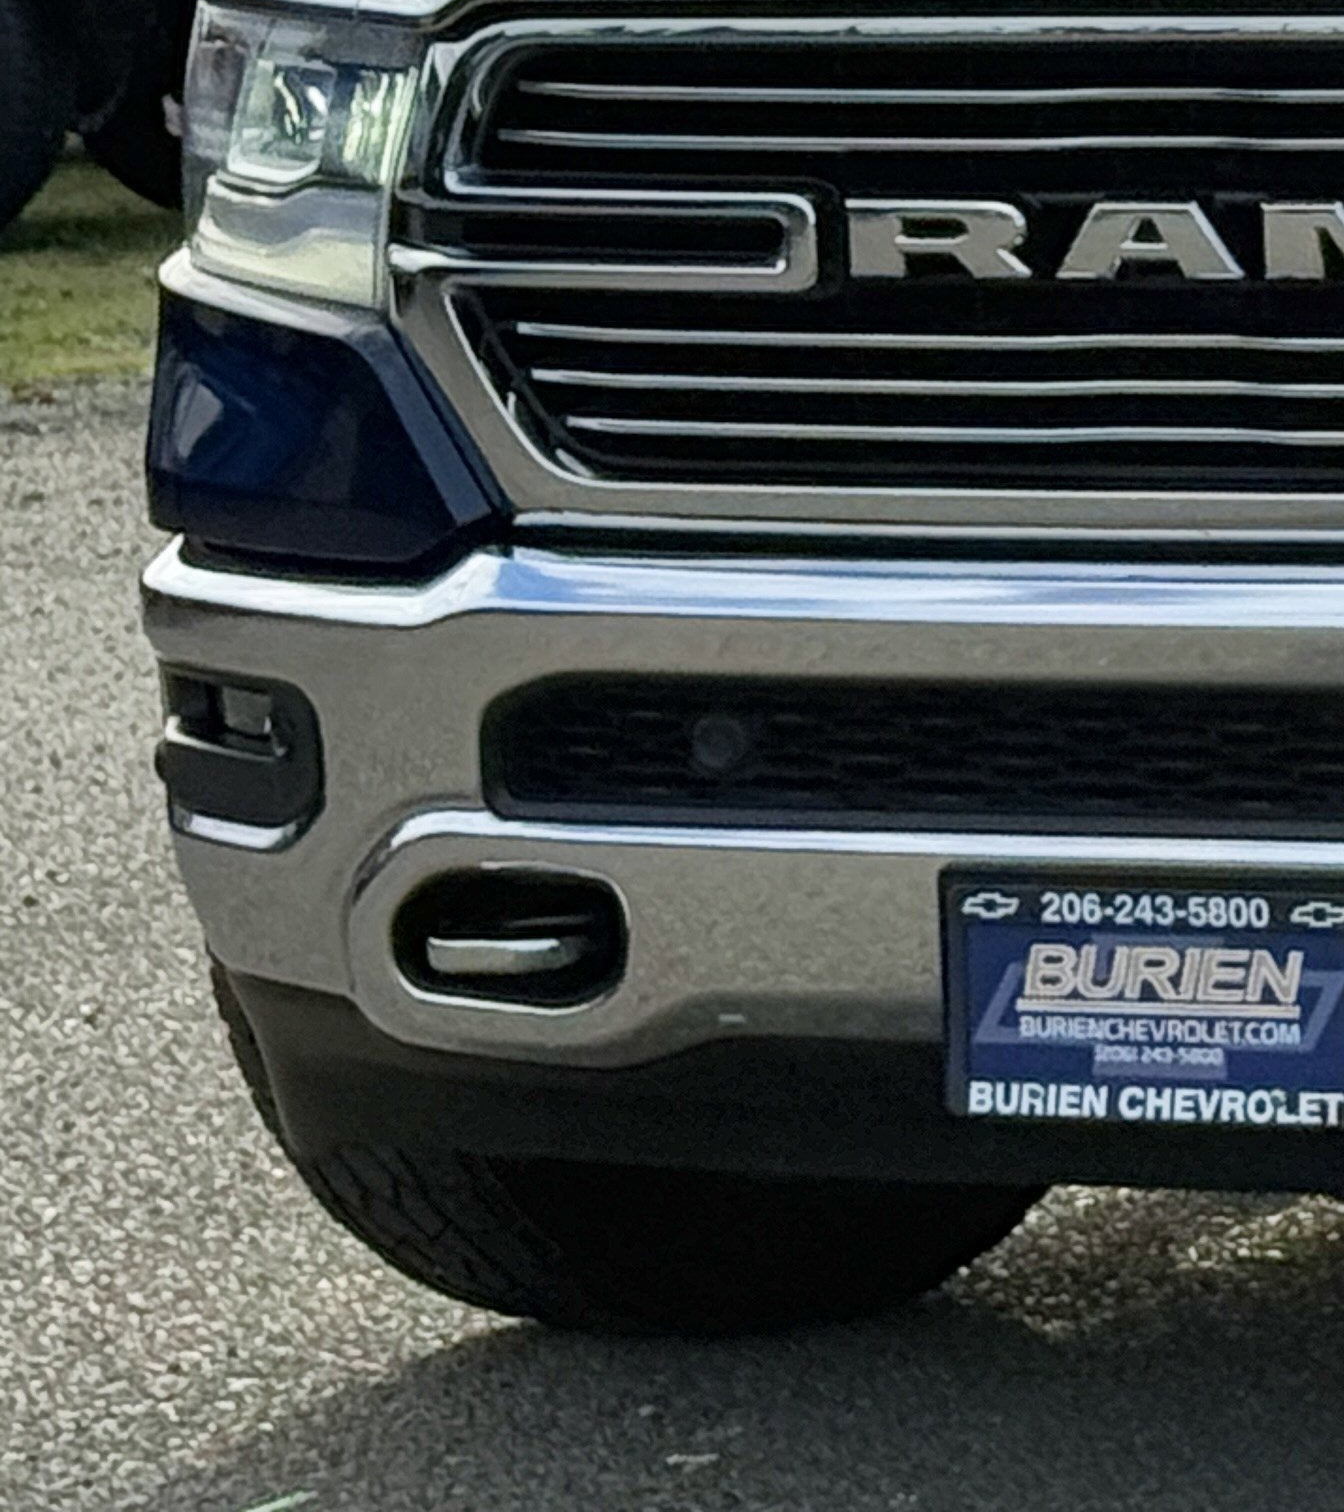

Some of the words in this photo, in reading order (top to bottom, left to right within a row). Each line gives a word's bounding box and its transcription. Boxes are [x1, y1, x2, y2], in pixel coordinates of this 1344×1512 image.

[1040, 891, 1270, 928] 206-243-5800
[1022, 942, 1304, 1004] BURIEN
[1019, 1015, 1300, 1045] BURIENCHEVROLET.COM
[968, 1080, 1108, 1117] BURIEN
